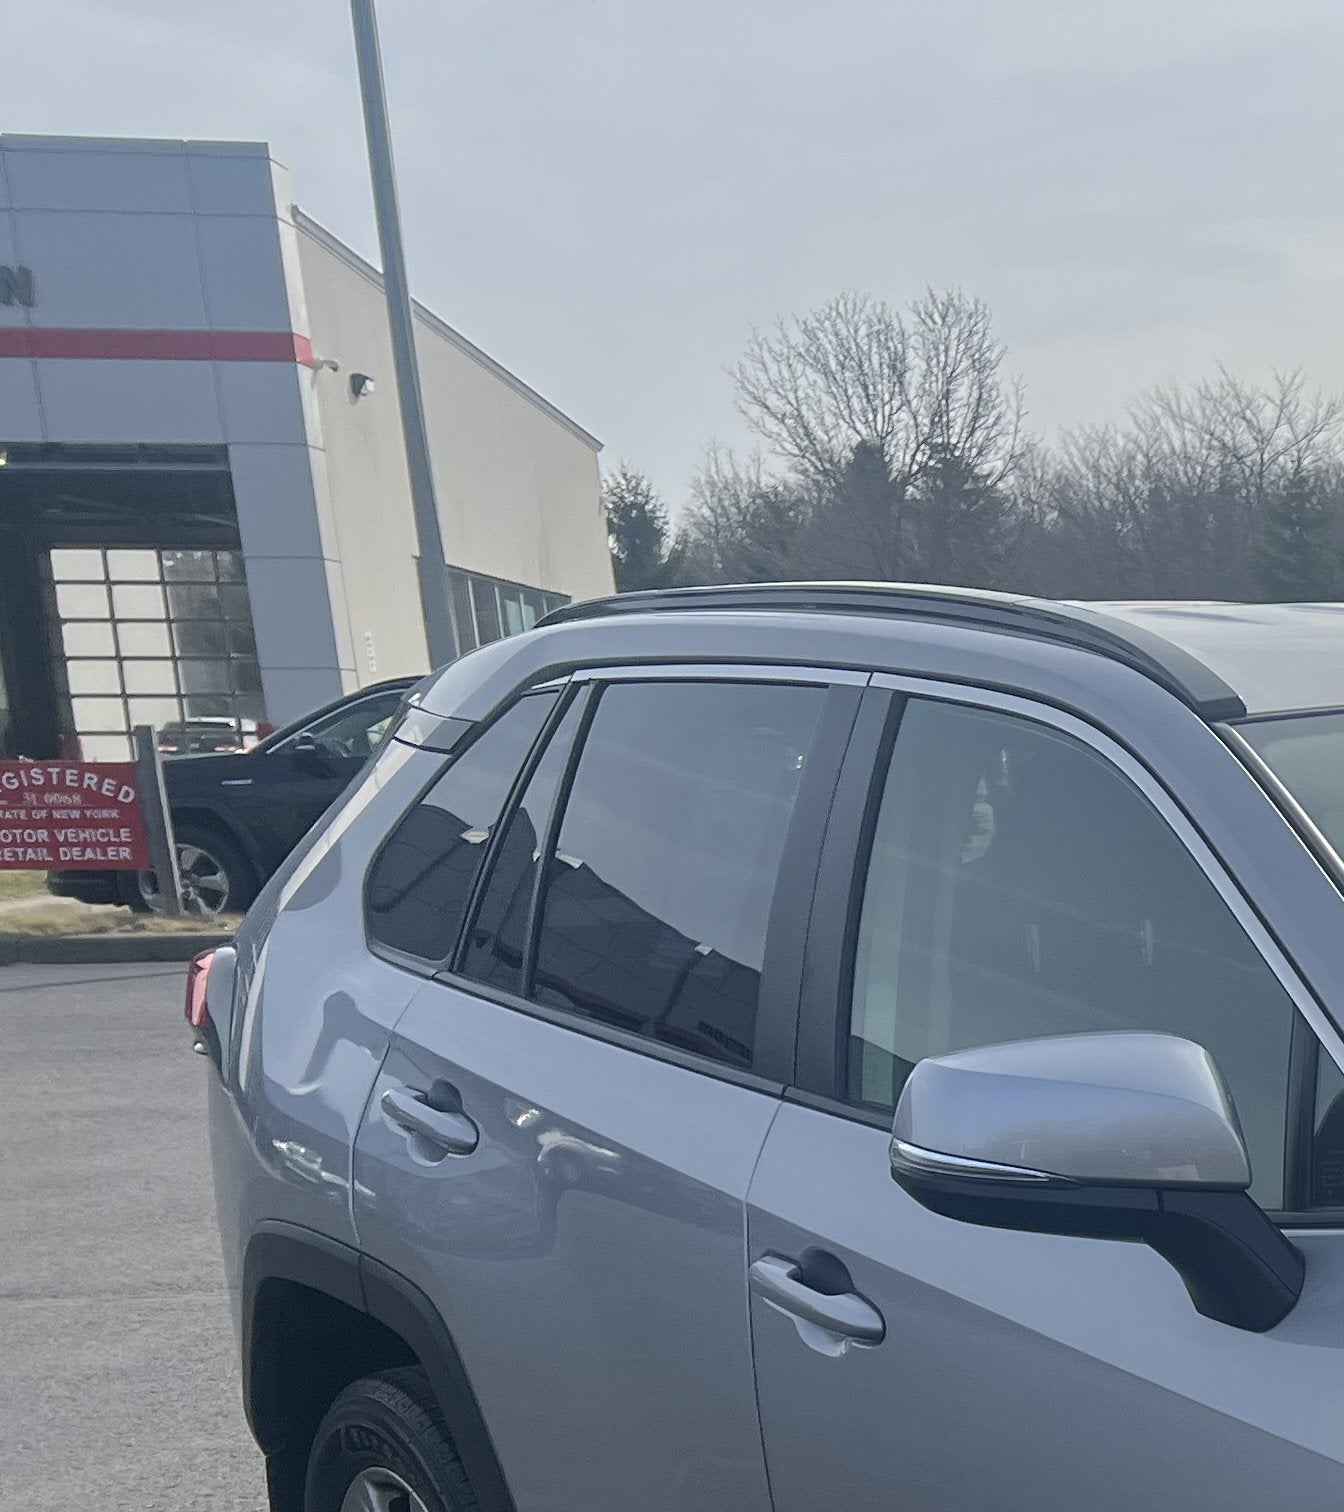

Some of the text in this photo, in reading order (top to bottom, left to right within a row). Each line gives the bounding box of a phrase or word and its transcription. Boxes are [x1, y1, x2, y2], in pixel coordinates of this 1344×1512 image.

[0, 768, 135, 803] GISTERED
[31, 809, 48, 819] OF
[52, 808, 80, 819] NEW
[54, 828, 132, 842] VEHICLE
[0, 847, 131, 861] ETAIL DEALER
